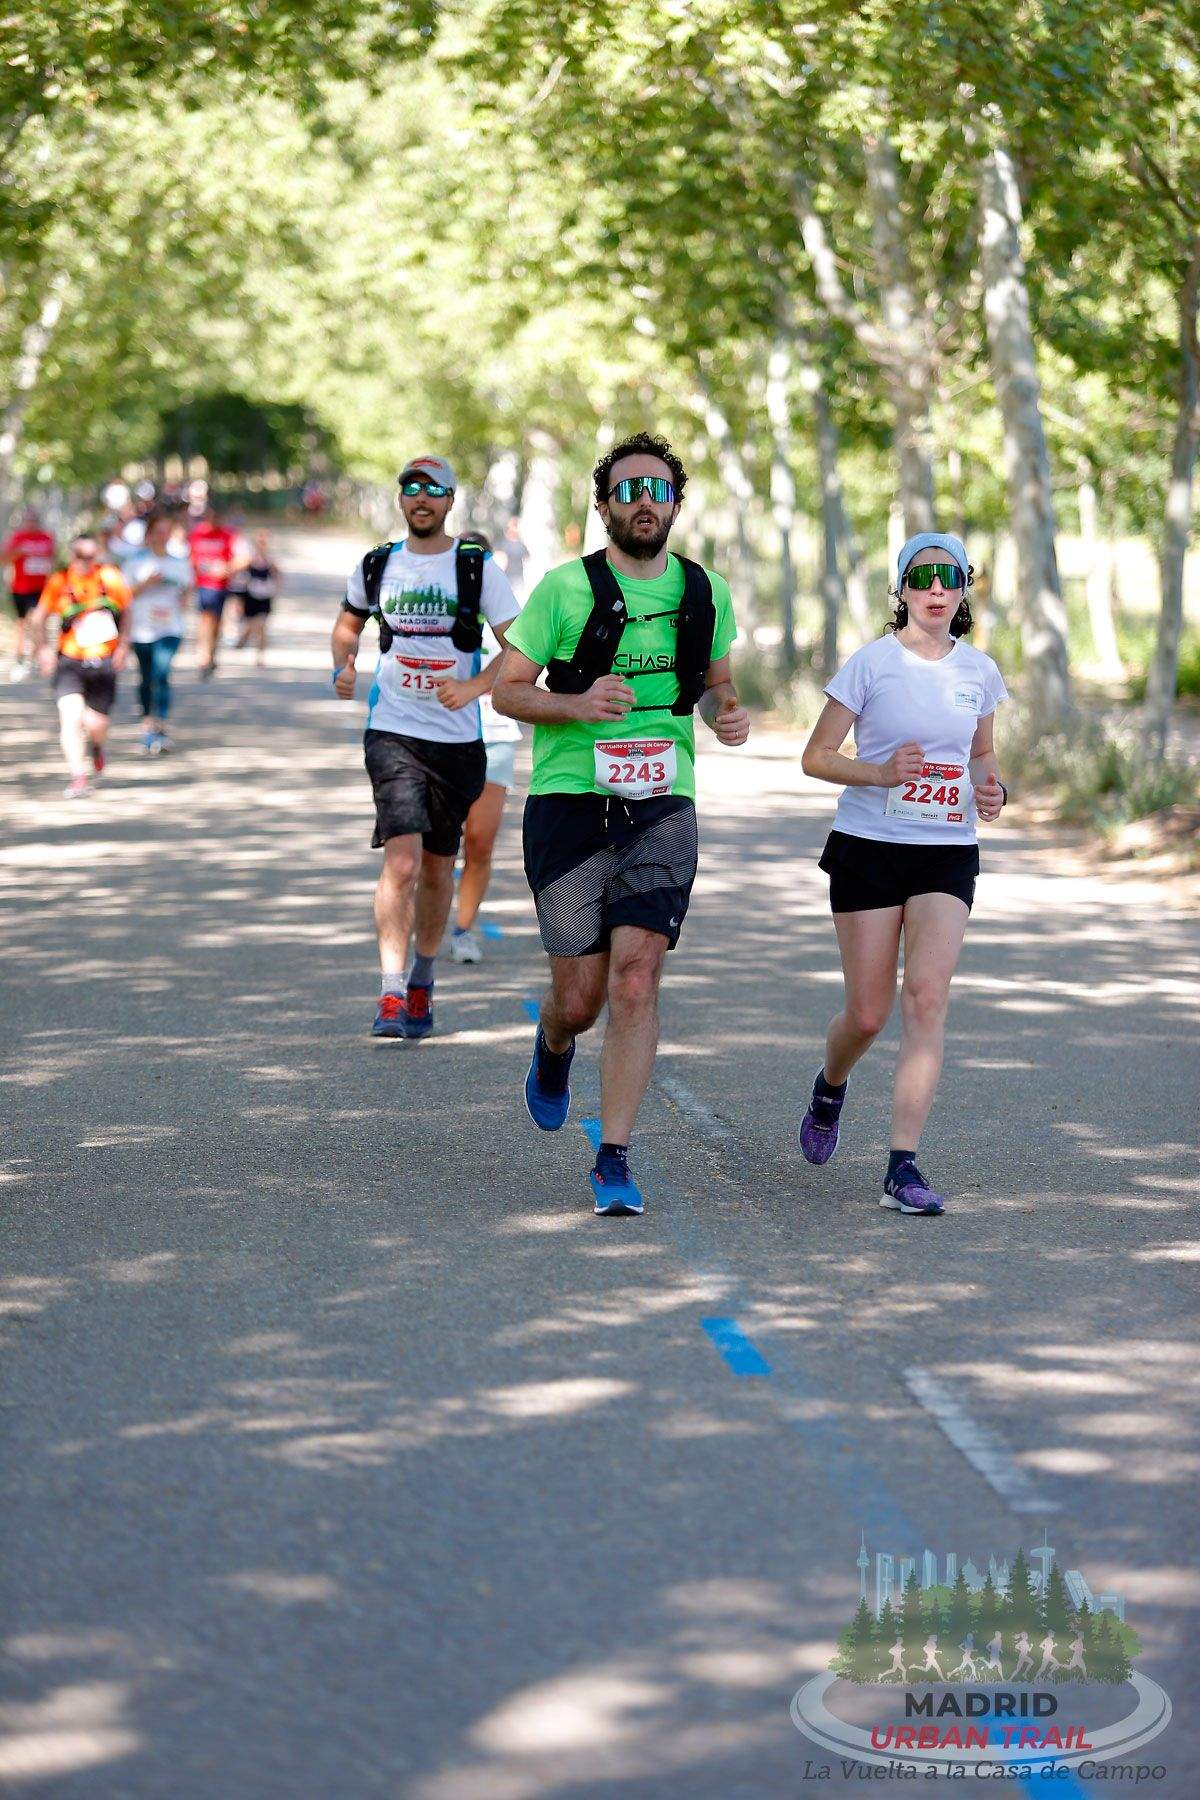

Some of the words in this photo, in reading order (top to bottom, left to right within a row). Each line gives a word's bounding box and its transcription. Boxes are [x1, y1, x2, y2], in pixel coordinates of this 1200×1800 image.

[402, 673, 446, 690] 213
[608, 762, 666, 784] 2243
[901, 781, 960, 806] 2248
